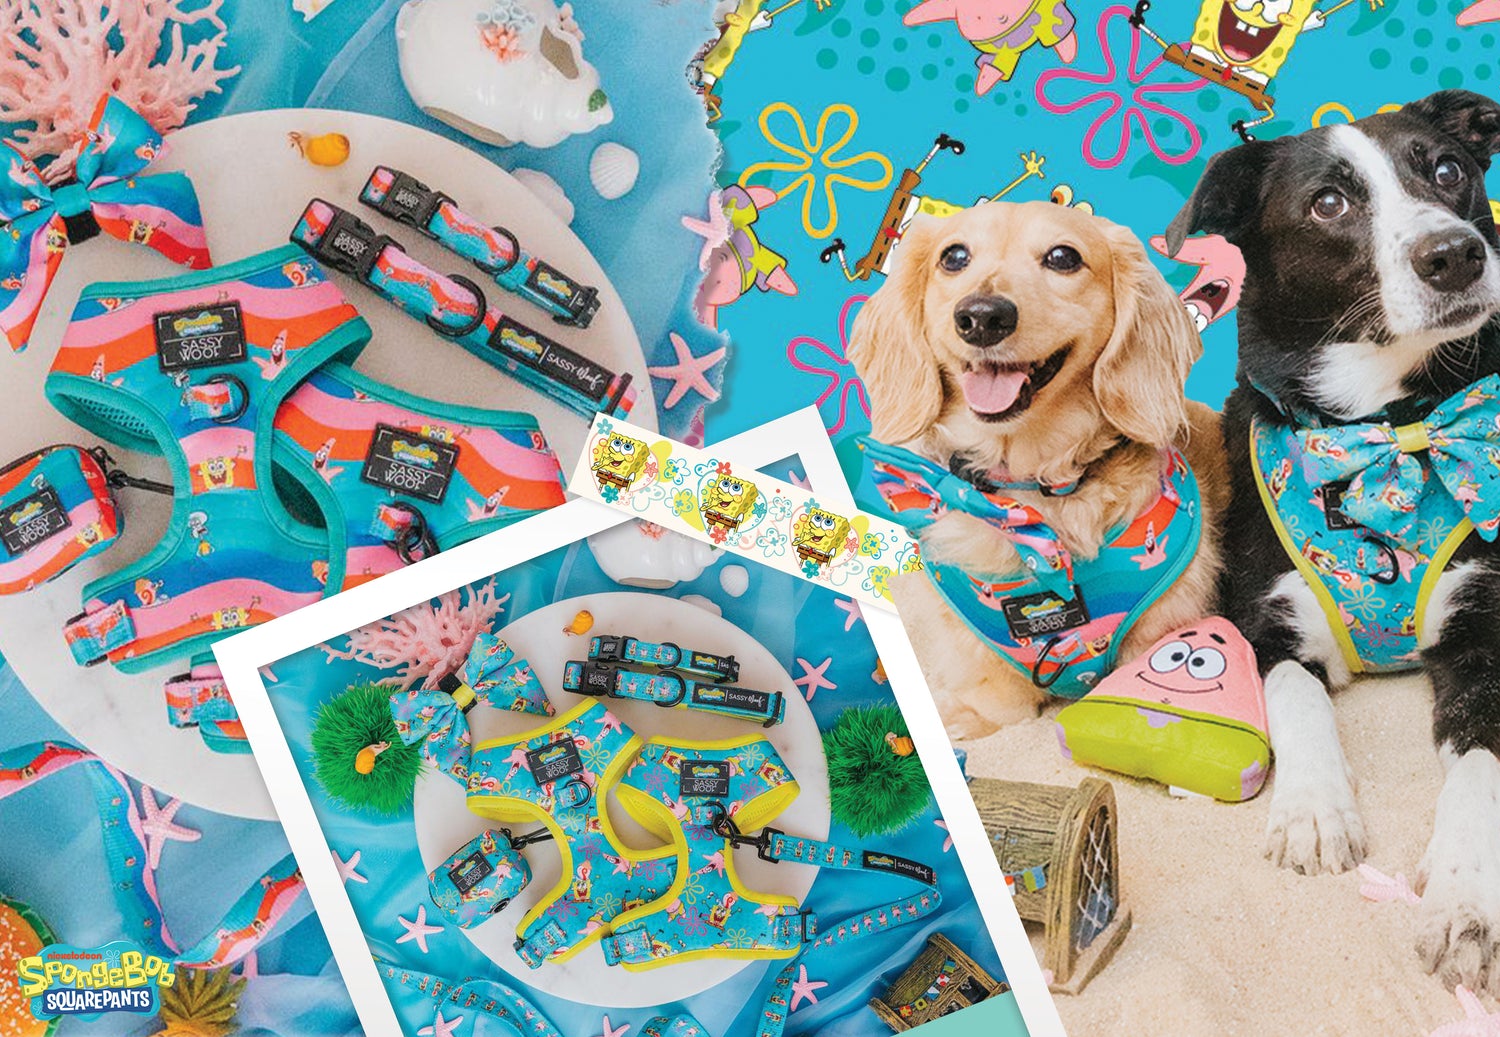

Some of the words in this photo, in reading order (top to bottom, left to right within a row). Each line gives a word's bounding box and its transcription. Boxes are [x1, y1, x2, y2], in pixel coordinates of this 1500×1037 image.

[181, 336, 223, 351] SASSY
[179, 347, 222, 361] WOOF
[546, 353, 578, 372] SASSY
[385, 469, 425, 490] WOOF
[390, 463, 431, 484] SASSY
